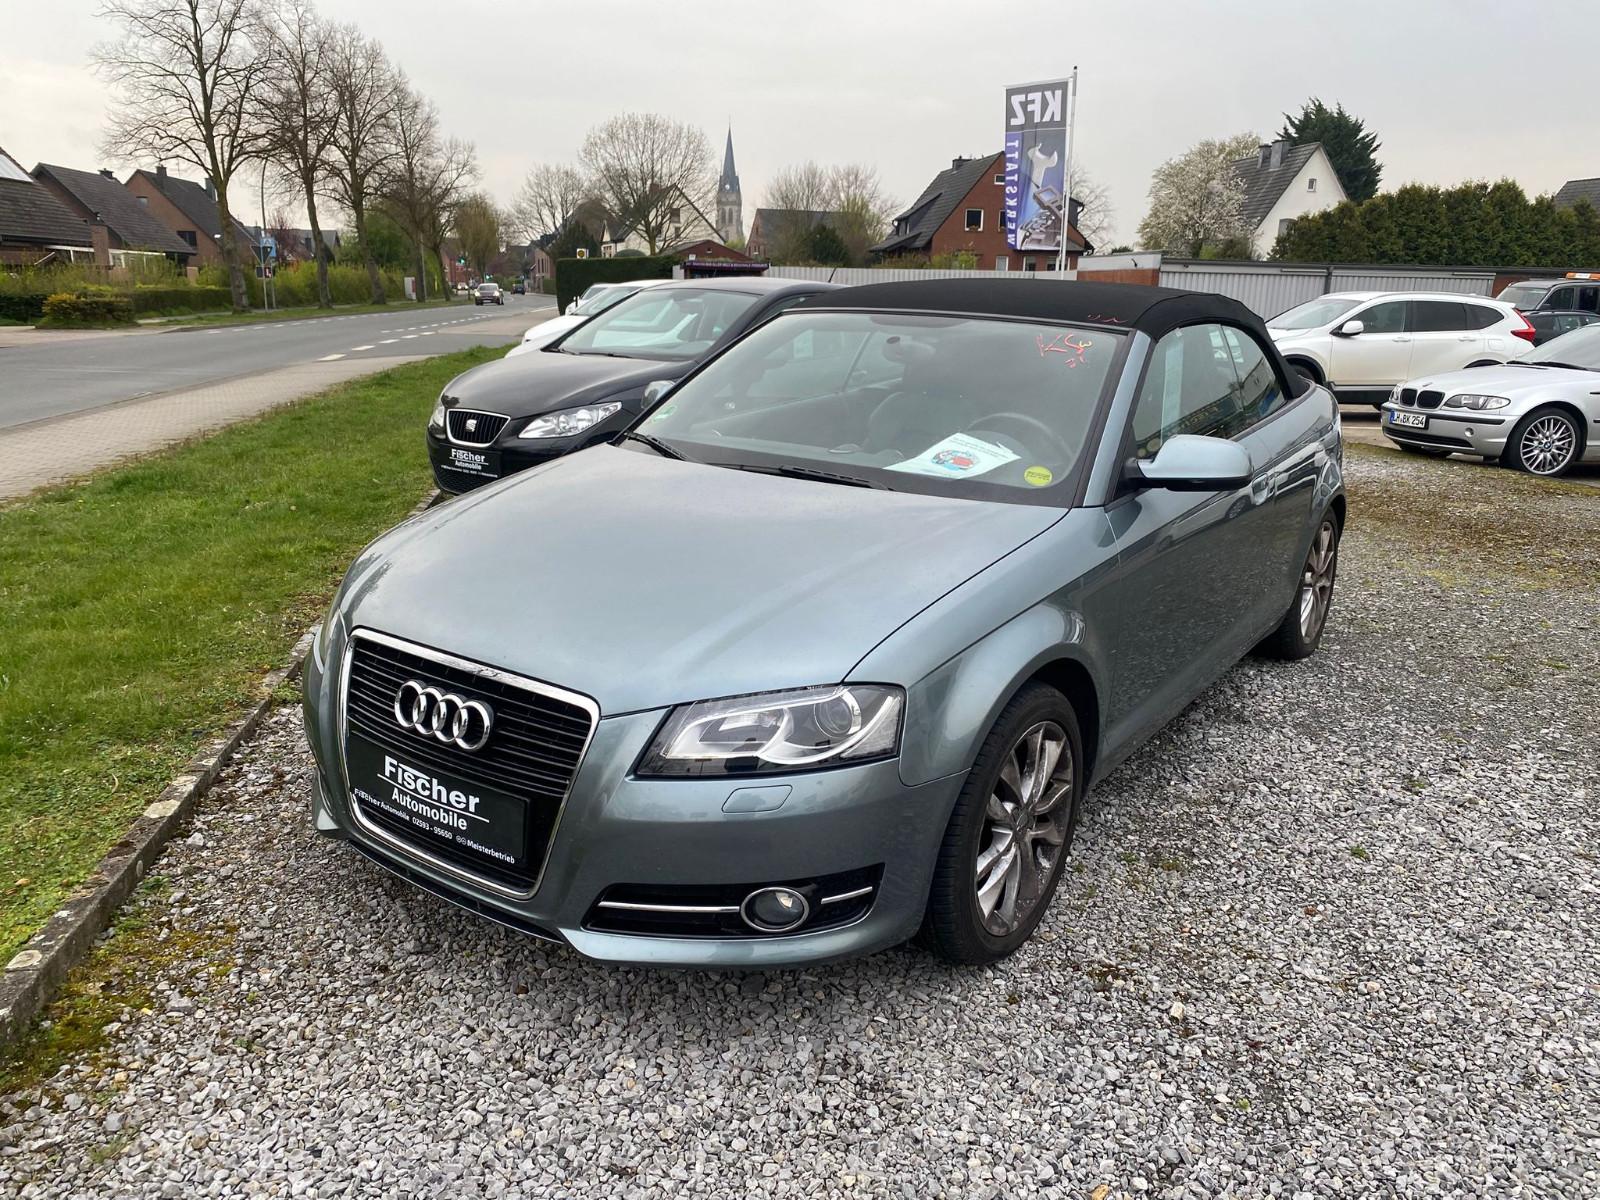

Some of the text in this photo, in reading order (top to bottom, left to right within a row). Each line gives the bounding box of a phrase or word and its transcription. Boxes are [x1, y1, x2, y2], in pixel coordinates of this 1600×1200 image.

[1411, 415, 1424, 426] 254
[451, 448, 485, 462] Fischer
[384, 755, 480, 813] Fischer
[354, 788, 380, 806] Fischer
[380, 801, 410, 821] Automobile
[467, 839, 515, 864] Meisterbetrieb
[391, 787, 468, 830] Automobile
